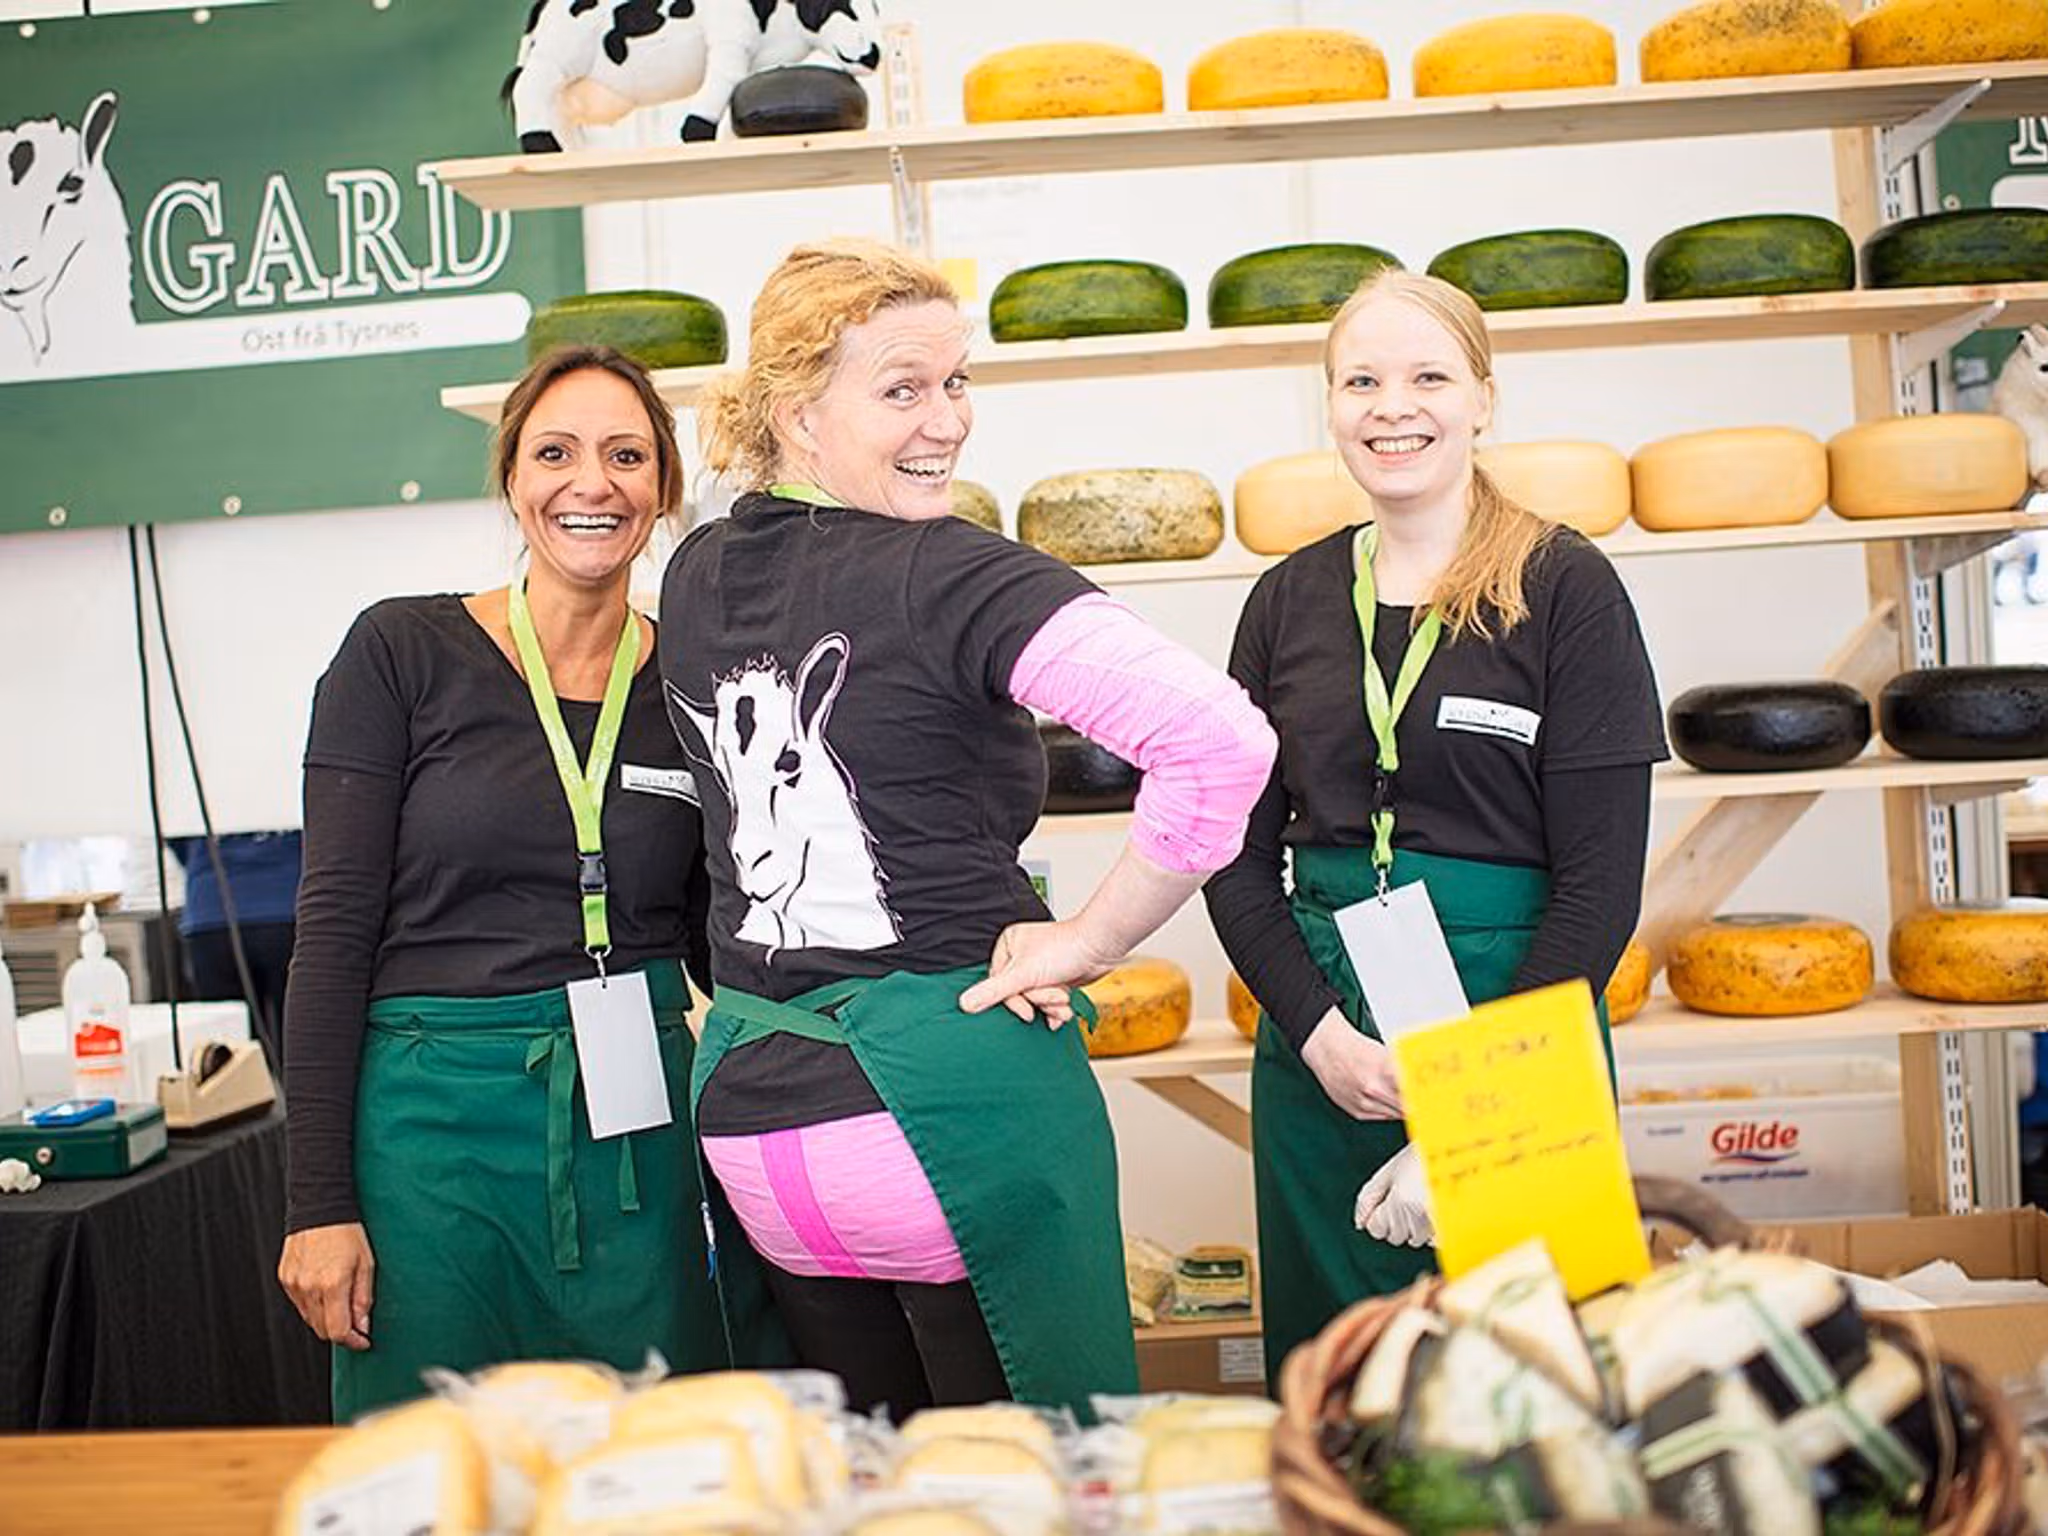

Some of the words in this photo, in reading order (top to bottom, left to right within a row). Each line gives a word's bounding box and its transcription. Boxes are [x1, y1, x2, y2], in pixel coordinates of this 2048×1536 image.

[142, 164, 512, 314] GARD
[242, 328, 285, 352] Ost
[335, 319, 420, 351] Tysnes
[1711, 1120, 1799, 1154] Gilde
